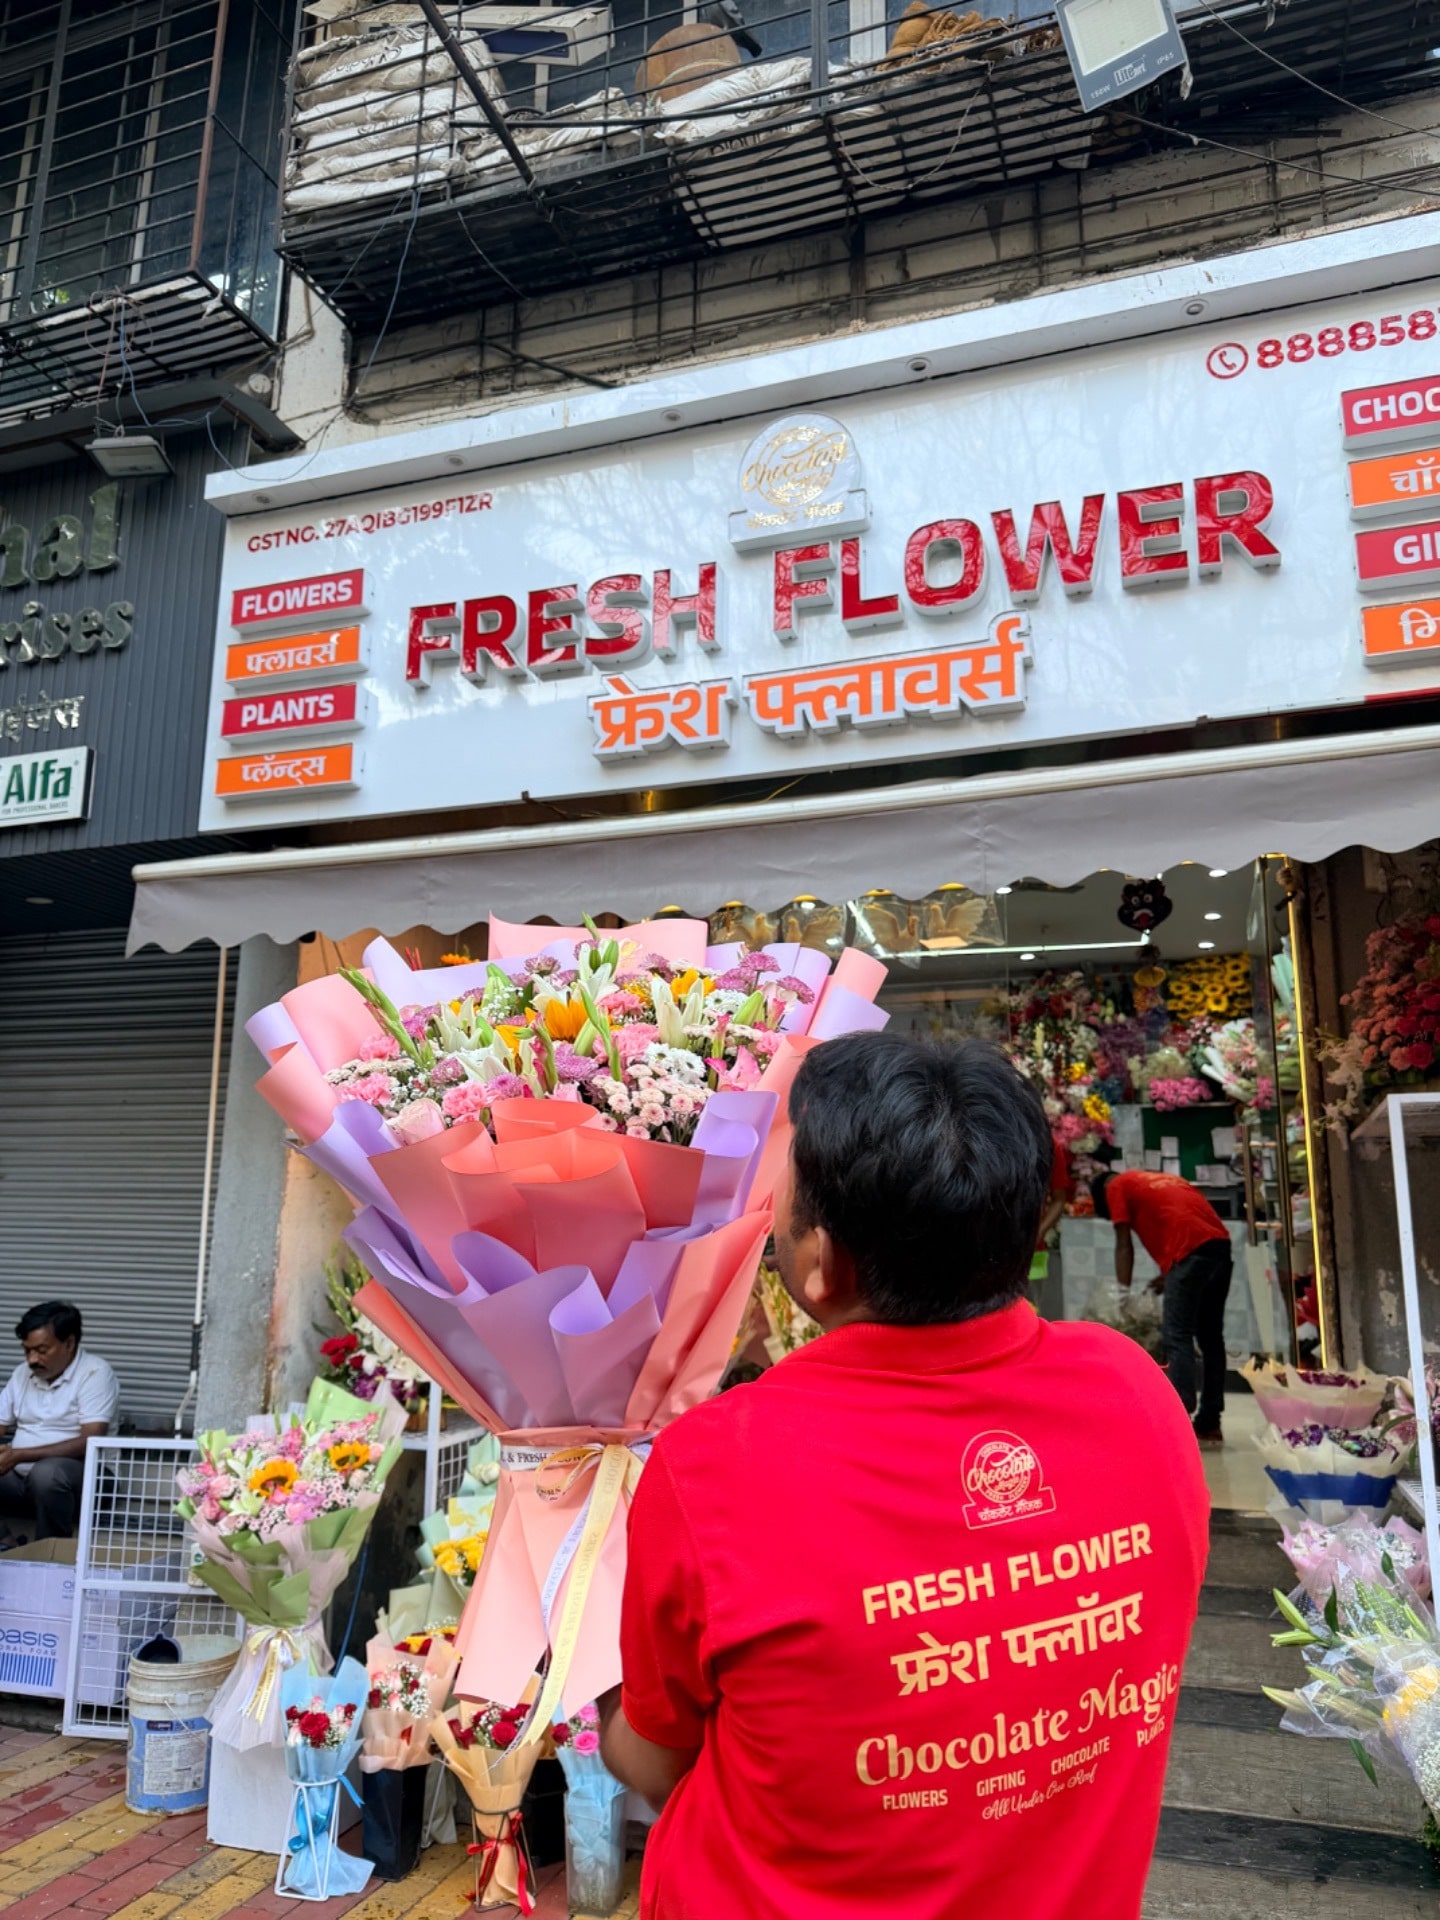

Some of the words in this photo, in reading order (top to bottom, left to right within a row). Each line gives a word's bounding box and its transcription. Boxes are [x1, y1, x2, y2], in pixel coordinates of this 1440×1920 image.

[1257, 306, 1440, 369] 888858
[240, 579, 353, 618] FLOWERS
[405, 561, 721, 687] FRESH
[773, 469, 1282, 638] FLOWER
[246, 632, 342, 674] फ्लावर्स
[592, 676, 732, 751] फ्रेश
[746, 615, 1025, 728] फ्लावर्स
[240, 693, 335, 729] PLANTS
[2, 757, 73, 807] Alfa
[862, 1562, 996, 1625] FRESH
[1007, 1522, 1153, 1592] FLOWER
[890, 1631, 992, 1697] फ्रेश
[1001, 1591, 1144, 1668] फ्लॉवर
[856, 1707, 1071, 1786] Chocolate
[1077, 1663, 1178, 1734] Magic
[882, 1788, 949, 1811] FLOWERS
[976, 1769, 1026, 1797] GIFTING
[1050, 1735, 1111, 1776] CHOCOLATE
